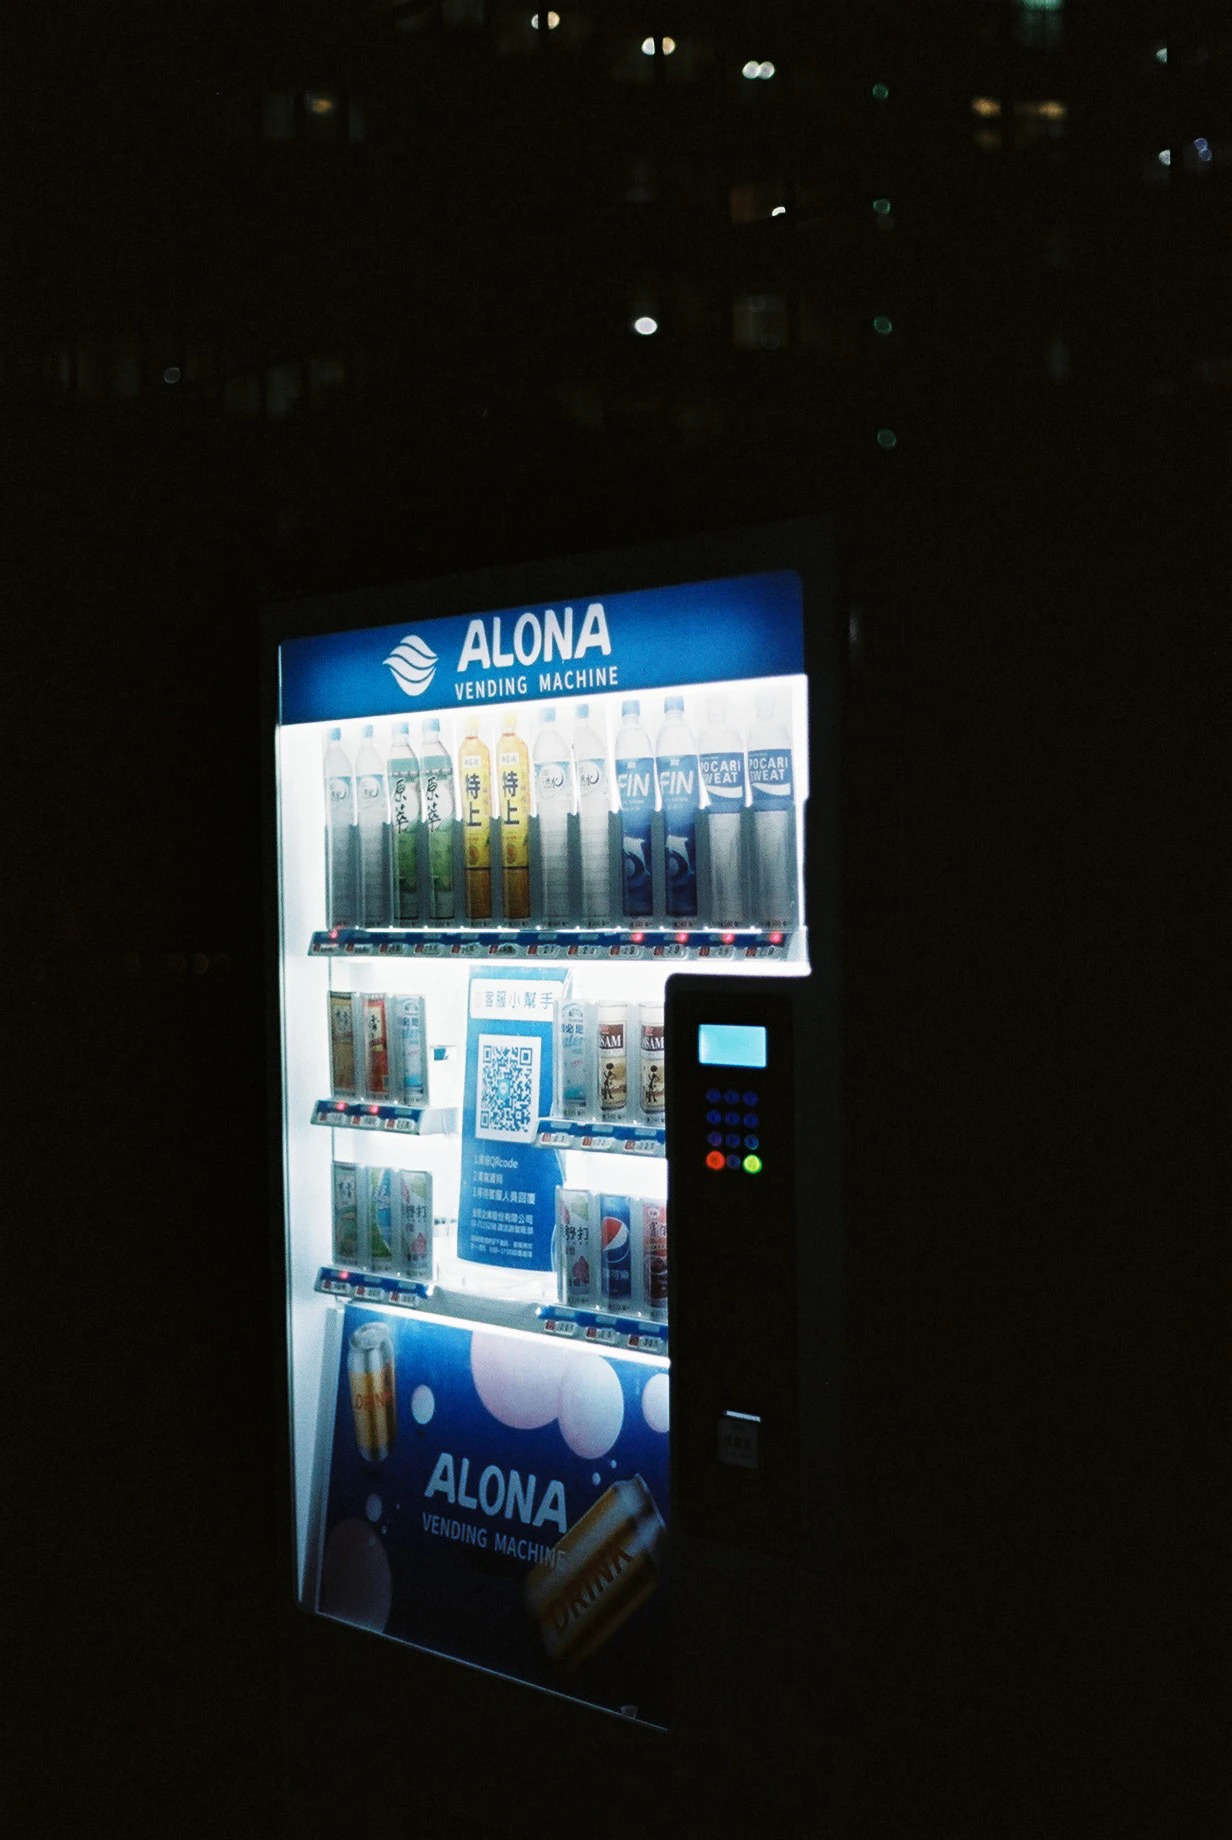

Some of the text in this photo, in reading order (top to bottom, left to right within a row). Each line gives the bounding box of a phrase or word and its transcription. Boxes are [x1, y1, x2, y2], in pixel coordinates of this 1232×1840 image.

[457, 603, 612, 672] ALONA
[455, 666, 619, 701] VENDING MACHINE
[426, 776, 442, 833] 原萃
[502, 770, 520, 825] 特上
[660, 770, 694, 796] FIN
[485, 990, 554, 1010] 客服小幫手
[424, 1452, 567, 1534] ALONA
[422, 1512, 488, 1549] VENDING
[551, 1547, 633, 1630] DRINK
